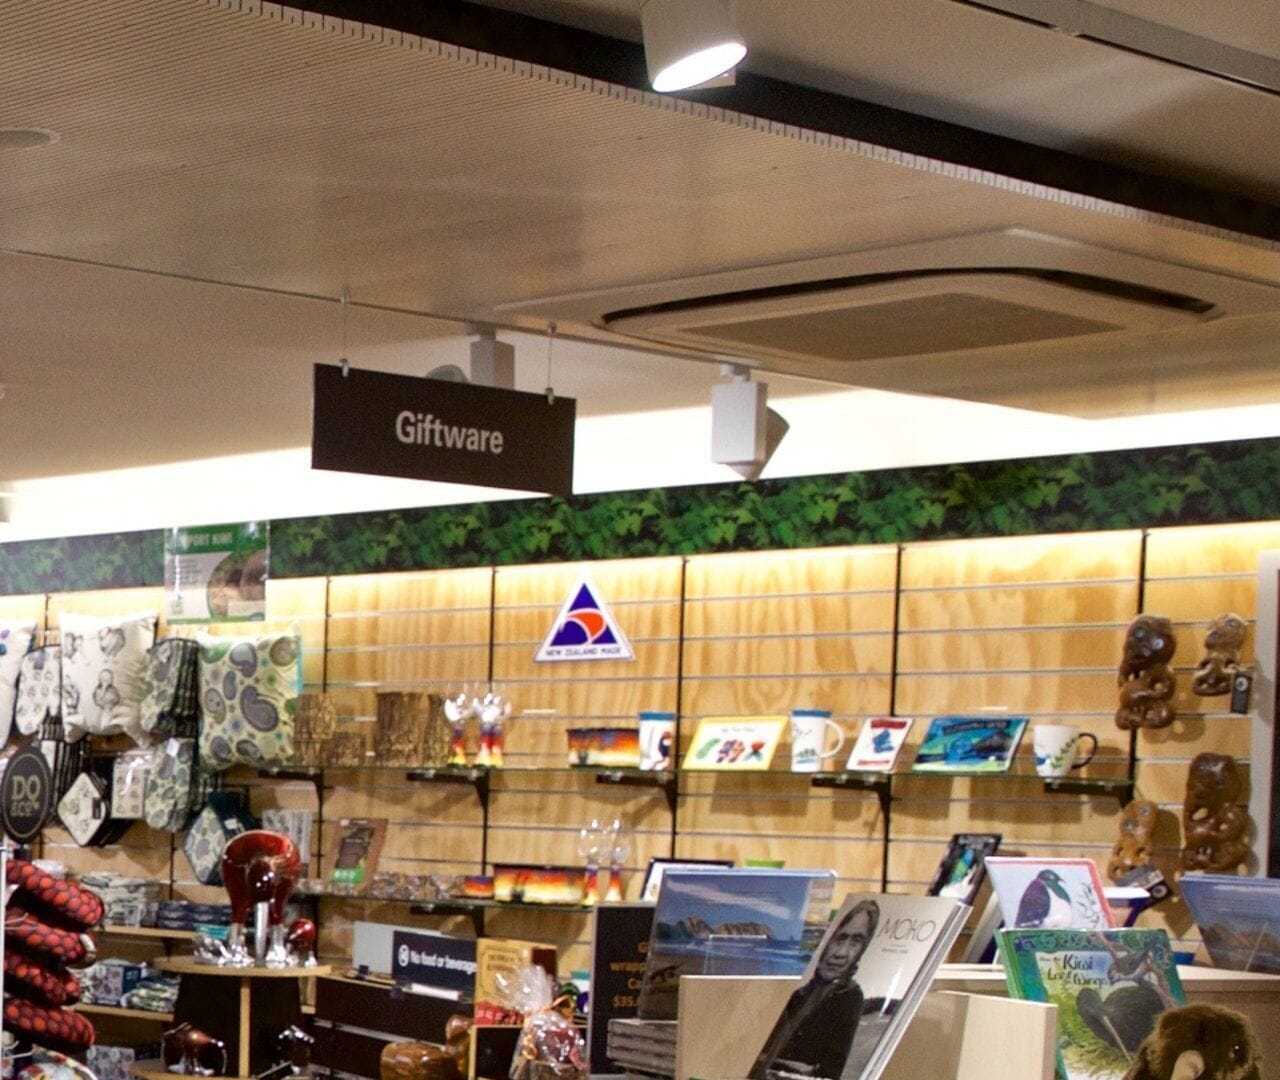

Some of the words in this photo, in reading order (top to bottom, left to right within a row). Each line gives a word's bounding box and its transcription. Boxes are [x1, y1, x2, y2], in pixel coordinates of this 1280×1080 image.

[395, 410, 504, 454] Giftware
[565, 648, 598, 657] ZEALAND
[876, 916, 937, 944] MOKO
[420, 950, 438, 967] food
[438, 954, 445, 967] or
[1062, 953, 1093, 971] Kiwi
